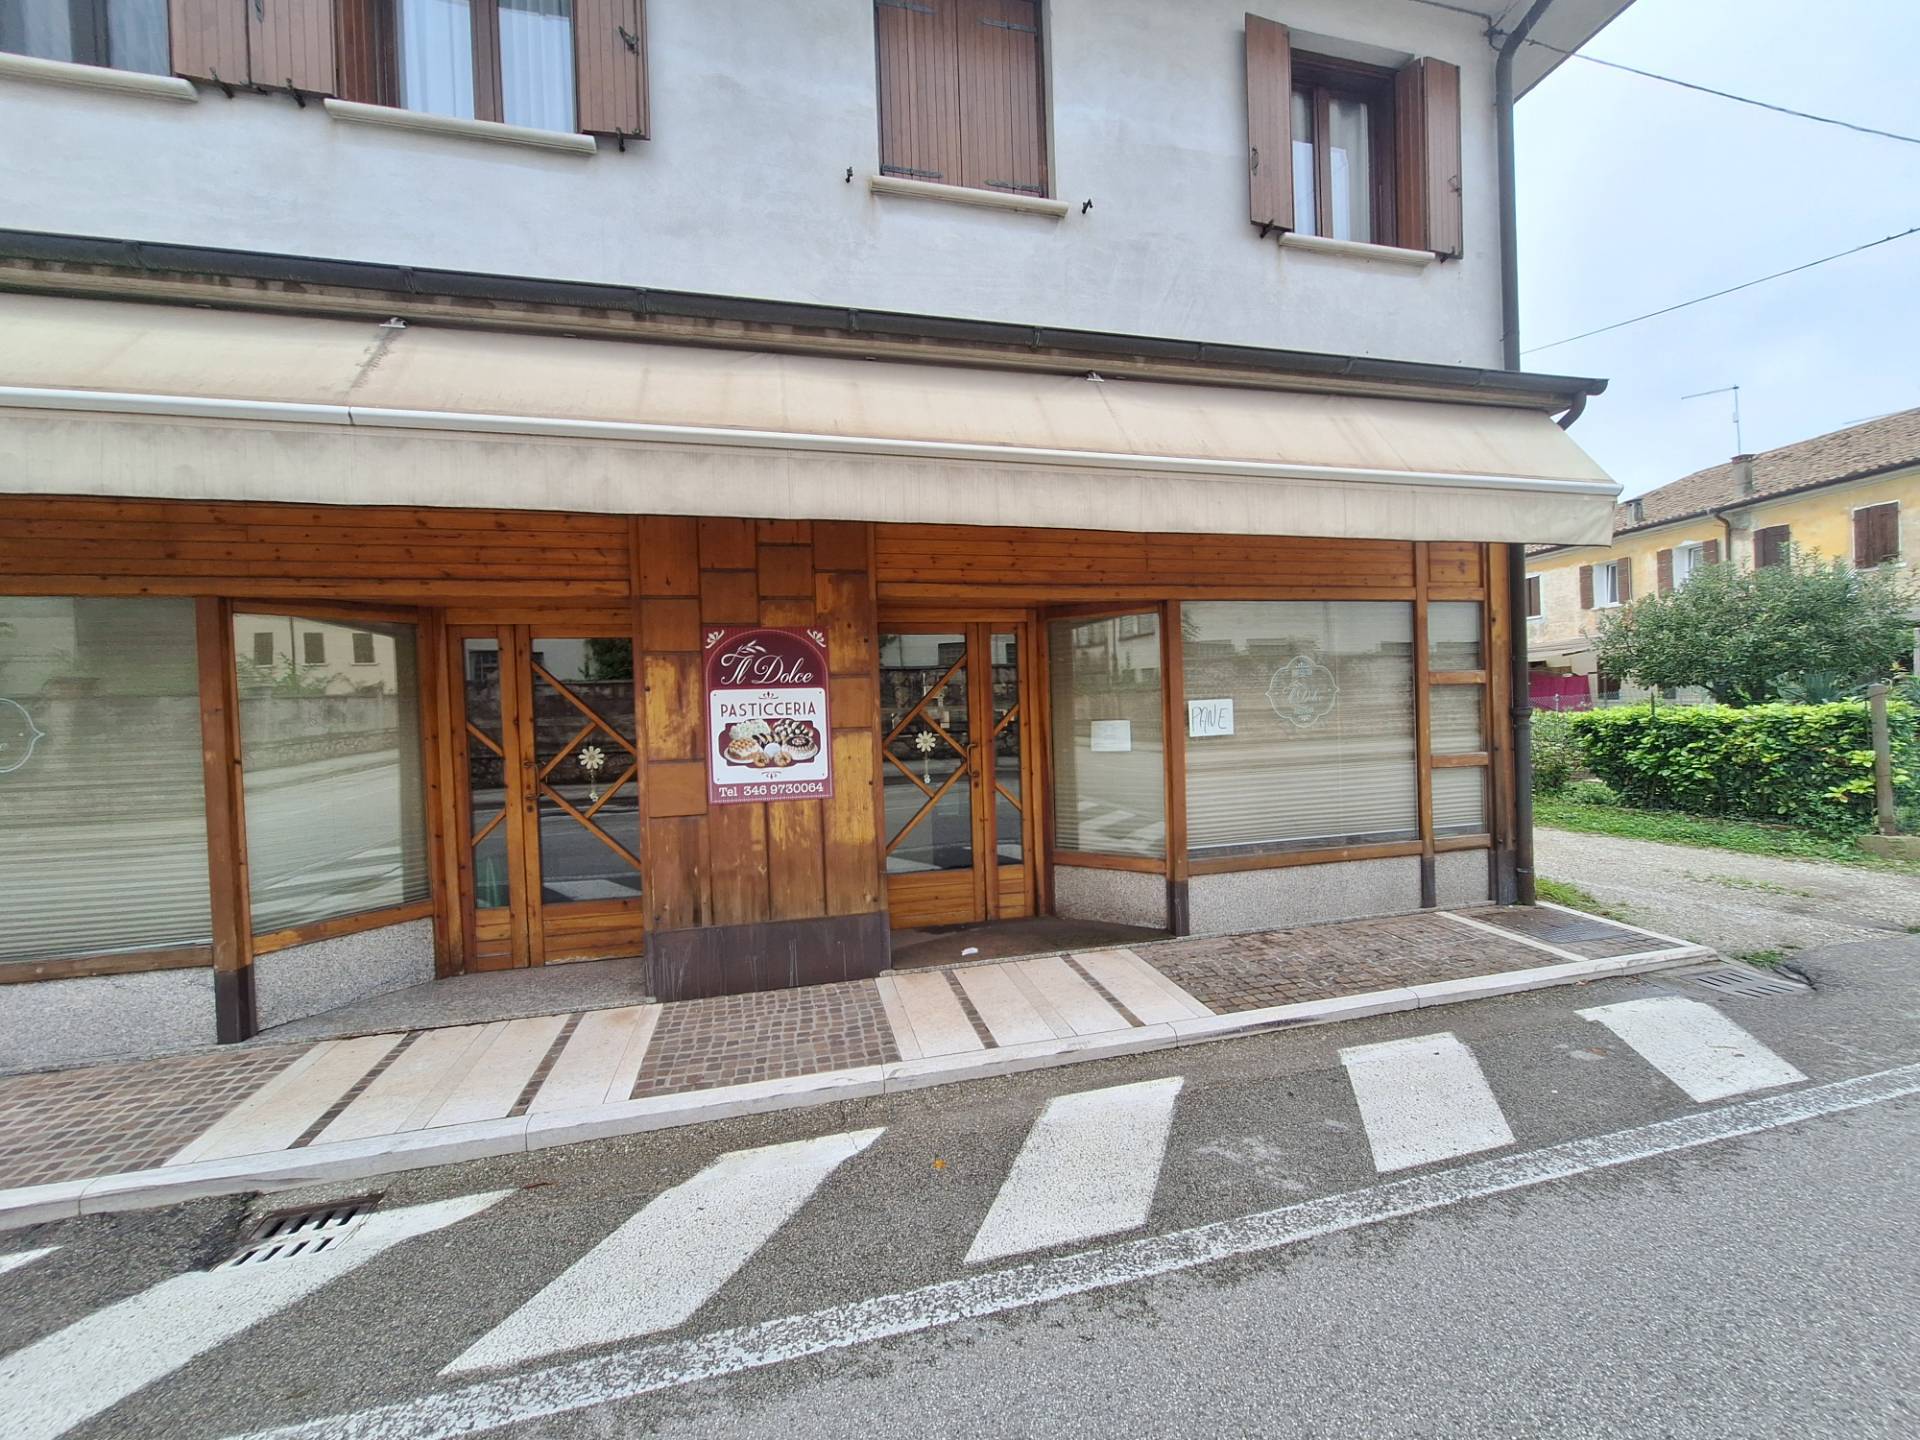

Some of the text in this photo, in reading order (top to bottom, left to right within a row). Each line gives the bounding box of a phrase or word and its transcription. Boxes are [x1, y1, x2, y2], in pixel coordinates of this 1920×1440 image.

[721, 652, 813, 685] Il Dolce
[720, 702, 816, 718] PASTICCERIA
[1191, 704, 1229, 734] PANE
[719, 782, 824, 798] Tel 346 9730064
